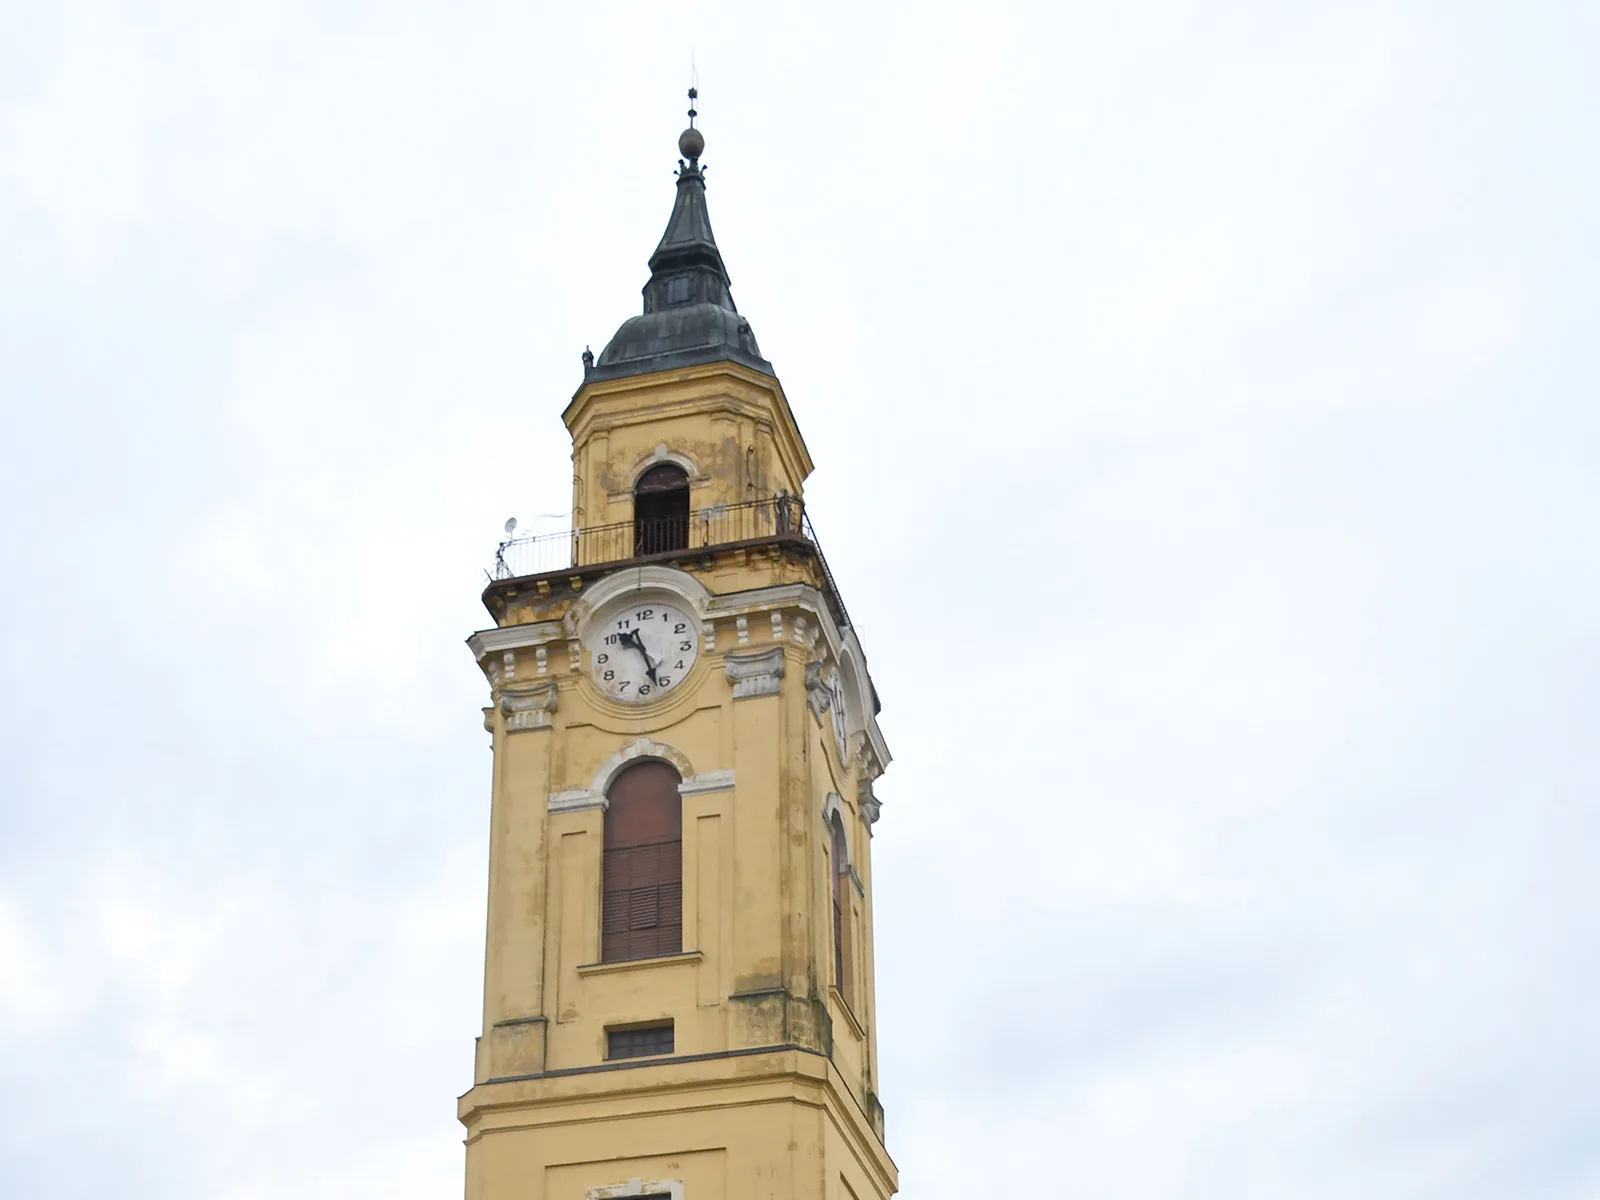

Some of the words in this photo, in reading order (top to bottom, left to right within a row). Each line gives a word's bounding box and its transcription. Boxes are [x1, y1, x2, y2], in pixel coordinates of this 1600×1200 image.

[635, 609, 654, 621] 12
[662, 613, 669, 622] 1
[617, 620, 630, 629] 11
[674, 623, 686, 634] 2
[604, 634, 617, 645] 10
[680, 640, 692, 651] 3
[597, 654, 609, 664] 9
[674, 660, 685, 669] 4
[603, 670, 615, 681] 8
[619, 681, 631, 692] 7
[659, 676, 671, 687] 5
[639, 684, 651, 695] 6
